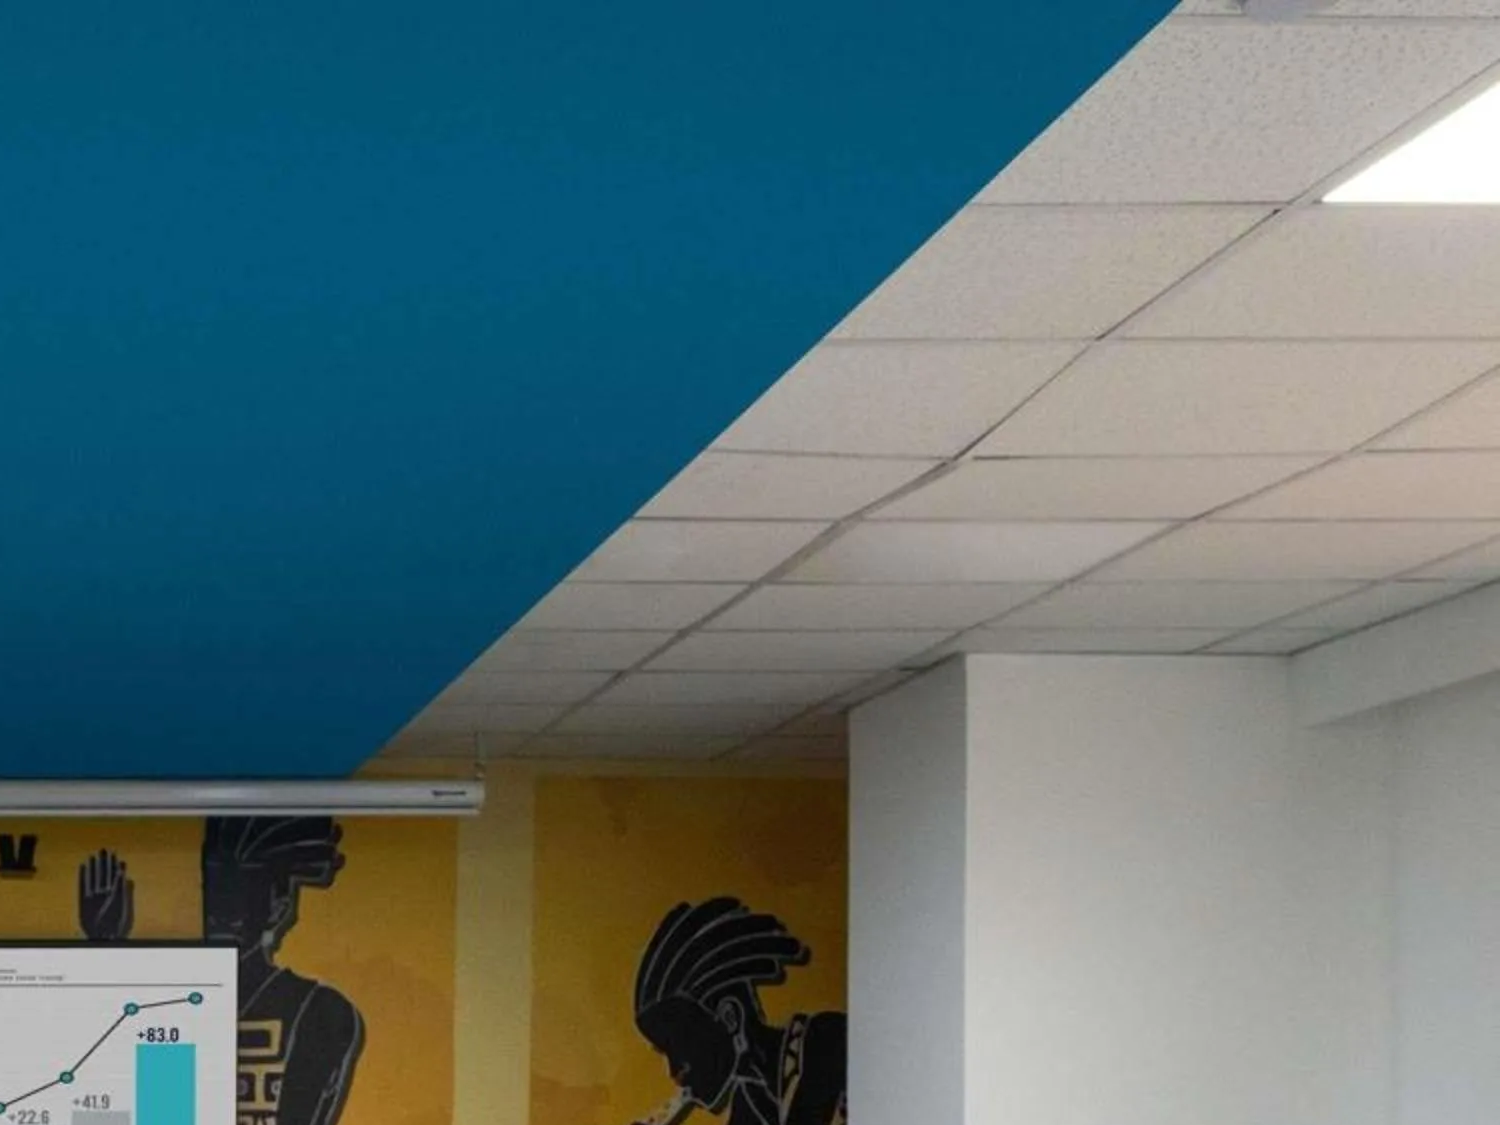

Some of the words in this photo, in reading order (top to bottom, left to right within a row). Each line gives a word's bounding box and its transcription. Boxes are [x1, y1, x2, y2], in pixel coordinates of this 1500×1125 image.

[137, 1028, 180, 1042] +83.0
[73, 1094, 110, 1109] +41.9
[7, 1110, 50, 1125] +22.6
